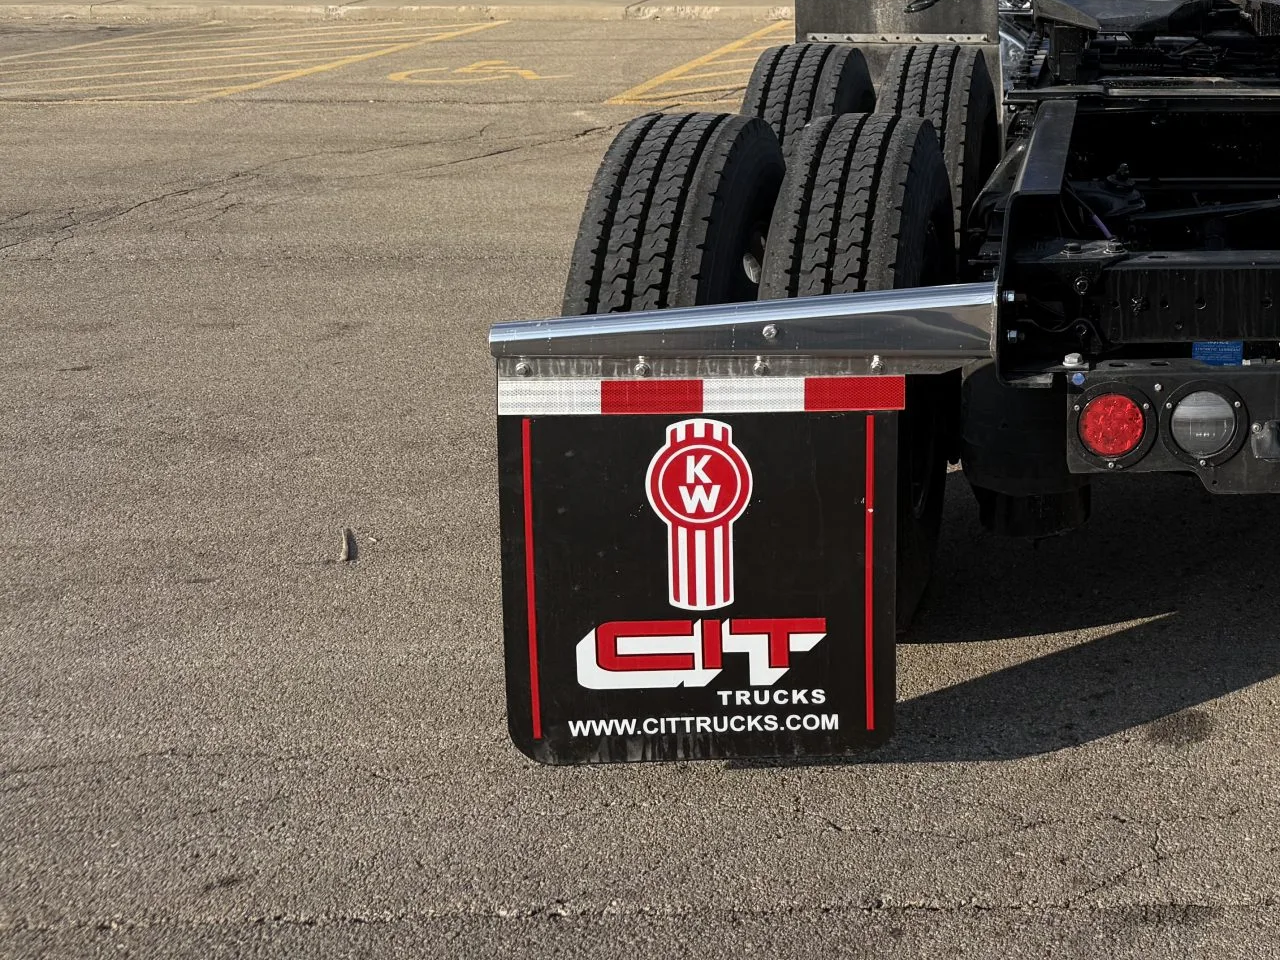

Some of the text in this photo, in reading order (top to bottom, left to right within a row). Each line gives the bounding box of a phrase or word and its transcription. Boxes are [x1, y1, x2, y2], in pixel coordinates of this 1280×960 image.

[575, 617, 827, 690] CIT
[717, 689, 827, 706] TRUCKS
[568, 714, 839, 737] WWW.CITTRUCKS.COM
